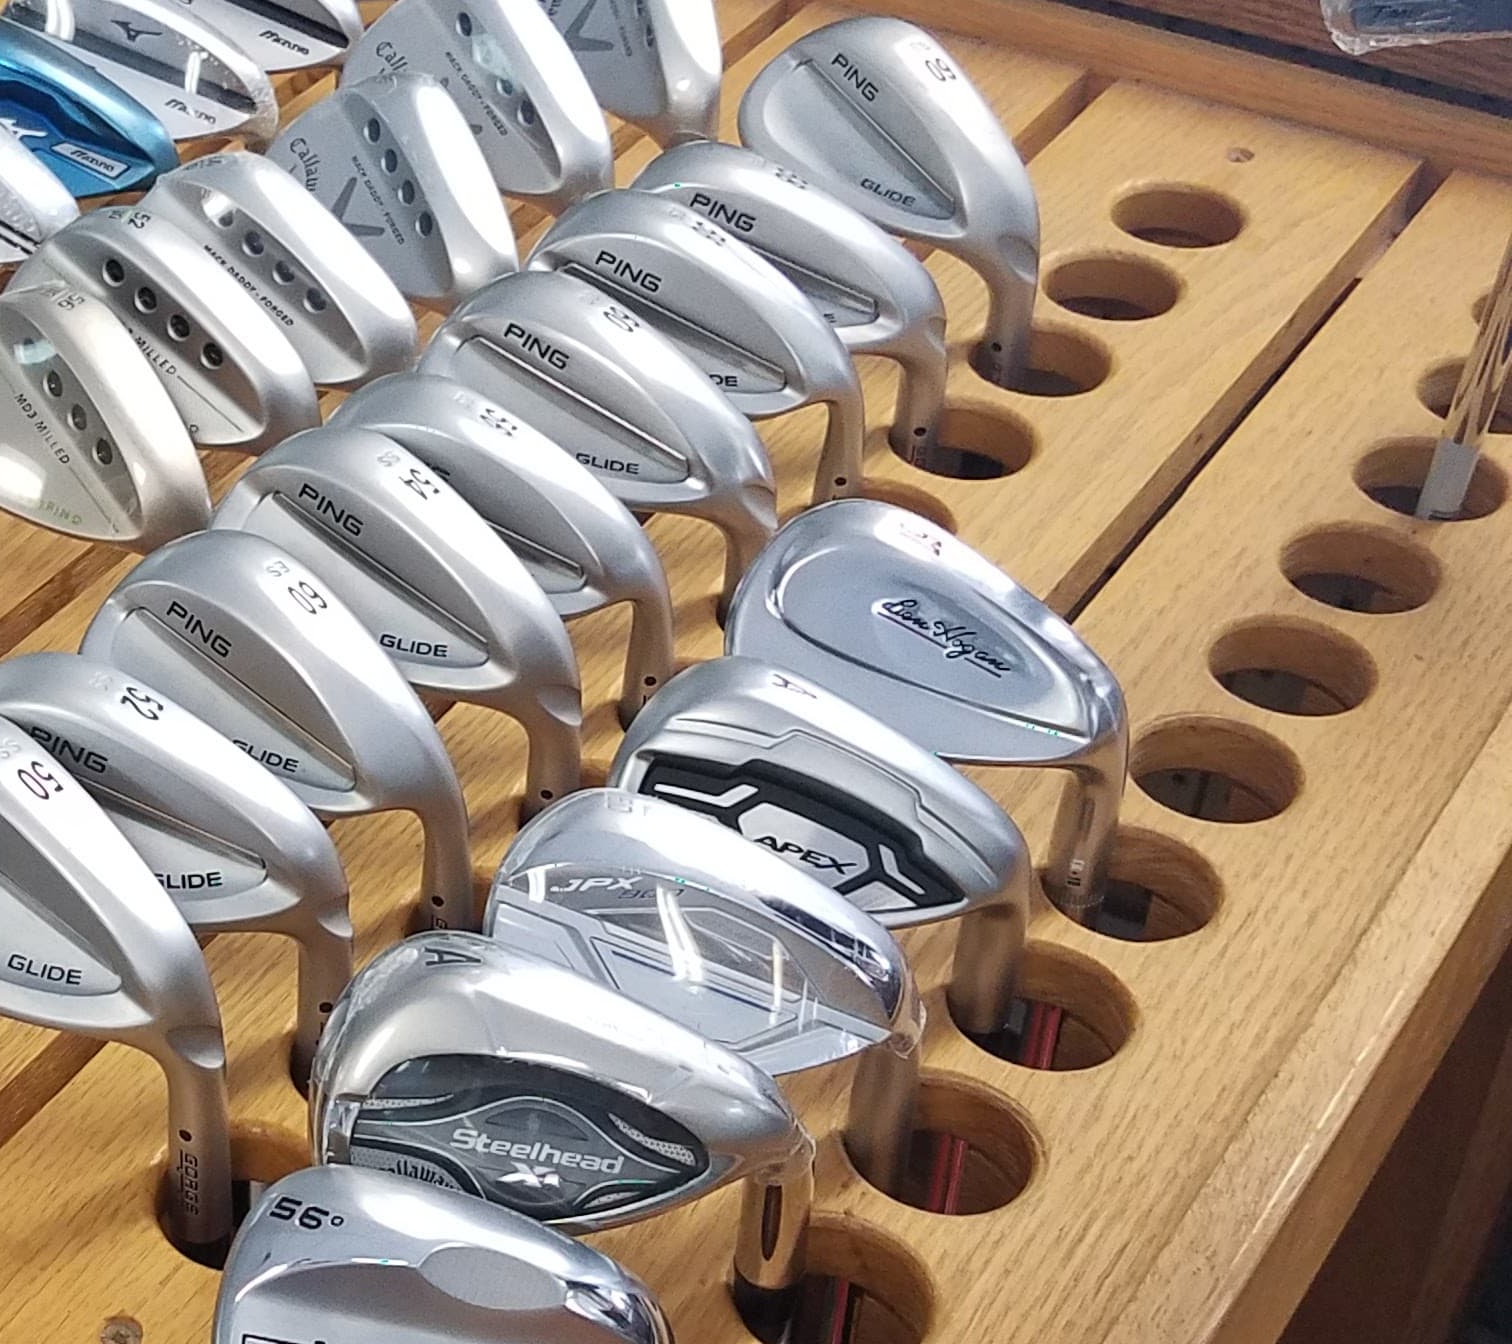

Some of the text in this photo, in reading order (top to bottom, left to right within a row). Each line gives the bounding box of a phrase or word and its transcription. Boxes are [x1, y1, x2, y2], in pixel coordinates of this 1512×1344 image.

[830, 52, 881, 103] PING
[924, 56, 957, 83] 60
[689, 192, 758, 234] PING
[858, 176, 918, 208] GLIDE
[203, 243, 296, 328] MACK DADDY FORGED
[595, 248, 664, 295] PING
[503, 321, 571, 371] PING
[13, 393, 71, 465] MD3 MILLED
[575, 451, 641, 476] GLIDE
[298, 482, 365, 537] PING
[287, 580, 329, 616] 60
[165, 599, 232, 658] PING
[379, 633, 449, 659] GLIDE
[932, 620, 1012, 672] Hogan
[118, 684, 167, 722] 52
[28, 725, 108, 775] PING
[232, 737, 300, 774] GLIDE
[14, 758, 67, 802] 50
[756, 832, 859, 877] APEX
[153, 869, 224, 890] GLIDE
[550, 875, 644, 893] JPX
[7, 952, 83, 987] GLIDE
[449, 1126, 625, 1177] Steelhead
[269, 1196, 345, 1232] 56°
